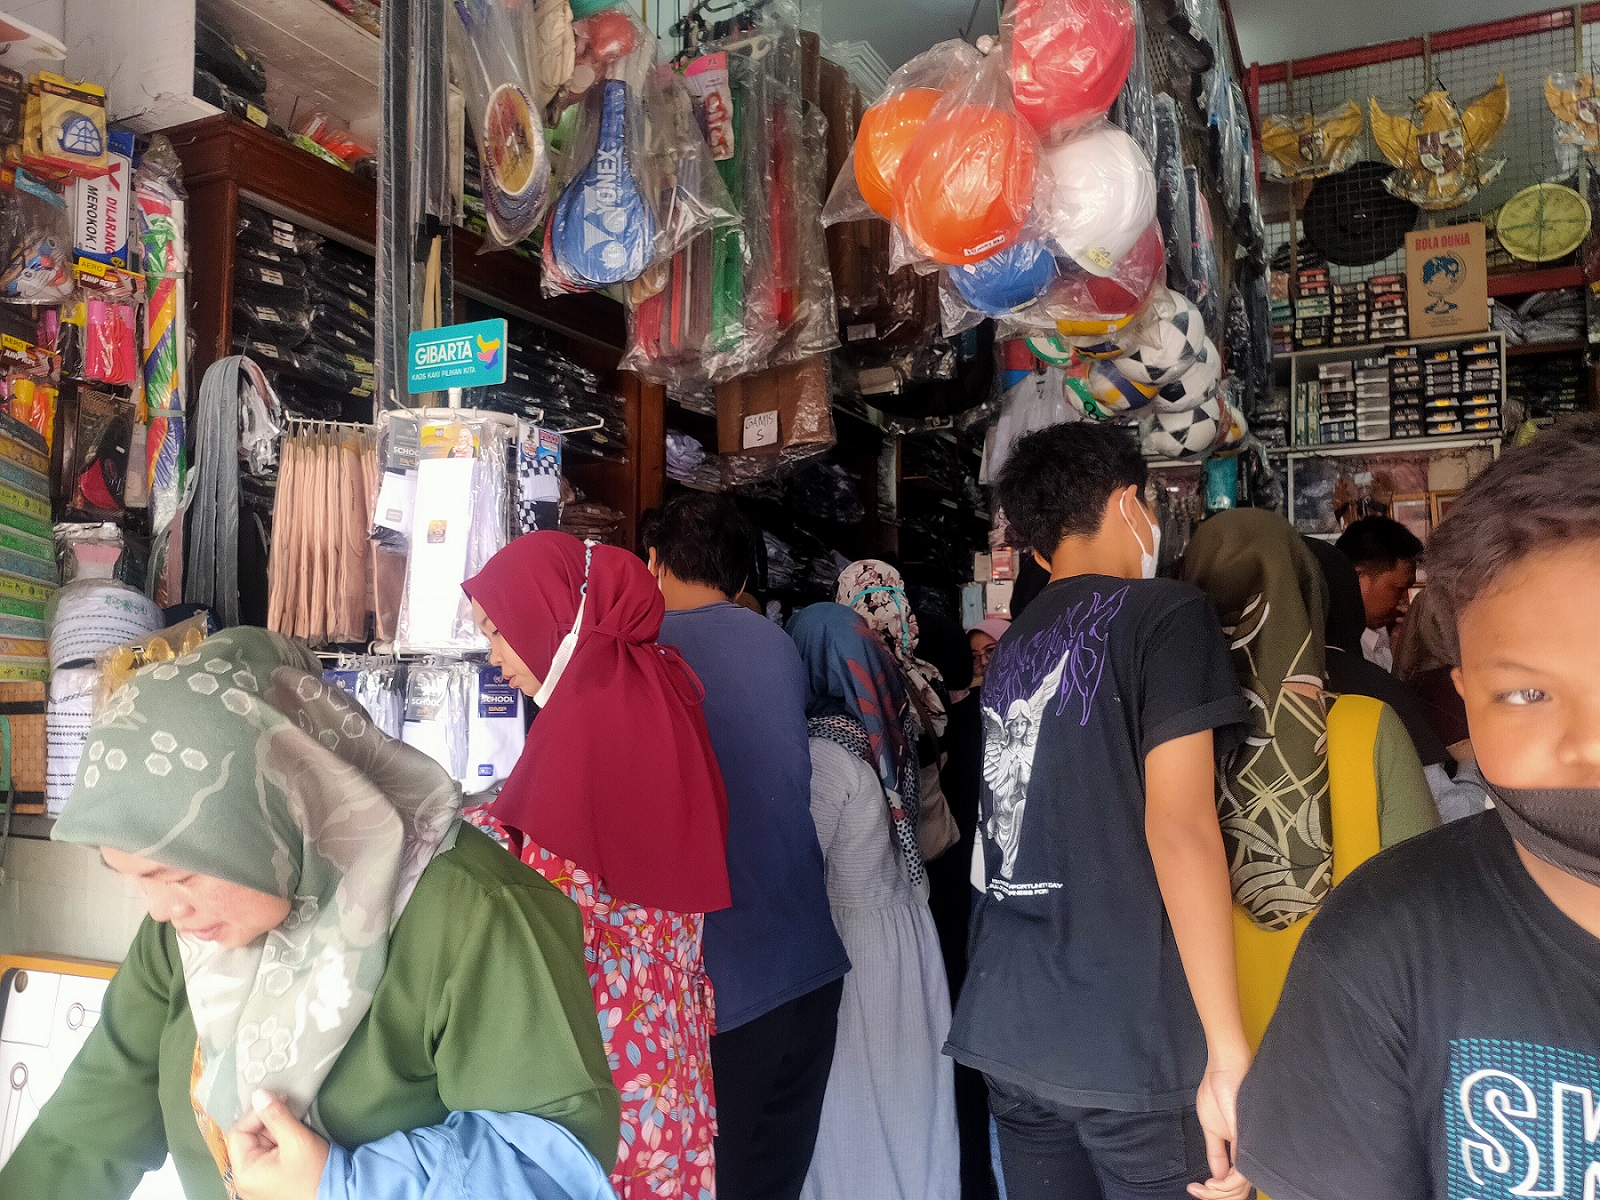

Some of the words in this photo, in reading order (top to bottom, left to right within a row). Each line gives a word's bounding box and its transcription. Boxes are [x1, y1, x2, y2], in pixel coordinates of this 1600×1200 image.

[104, 196, 117, 254] DILARANG
[1415, 236, 1439, 251] BOLA
[1441, 231, 1471, 248] DUNIA
[81, 261, 102, 272] AERO
[81, 274, 99, 284] JUMP
[415, 340, 473, 365] GIBARTA
[411, 372, 426, 381] KAOS
[427, 371, 440, 379] KAKI
[441, 369, 462, 377] PILIHAN
[463, 366, 476, 374] KITA
[757, 428, 764, 441] S
[481, 695, 514, 703] SCHOOL
